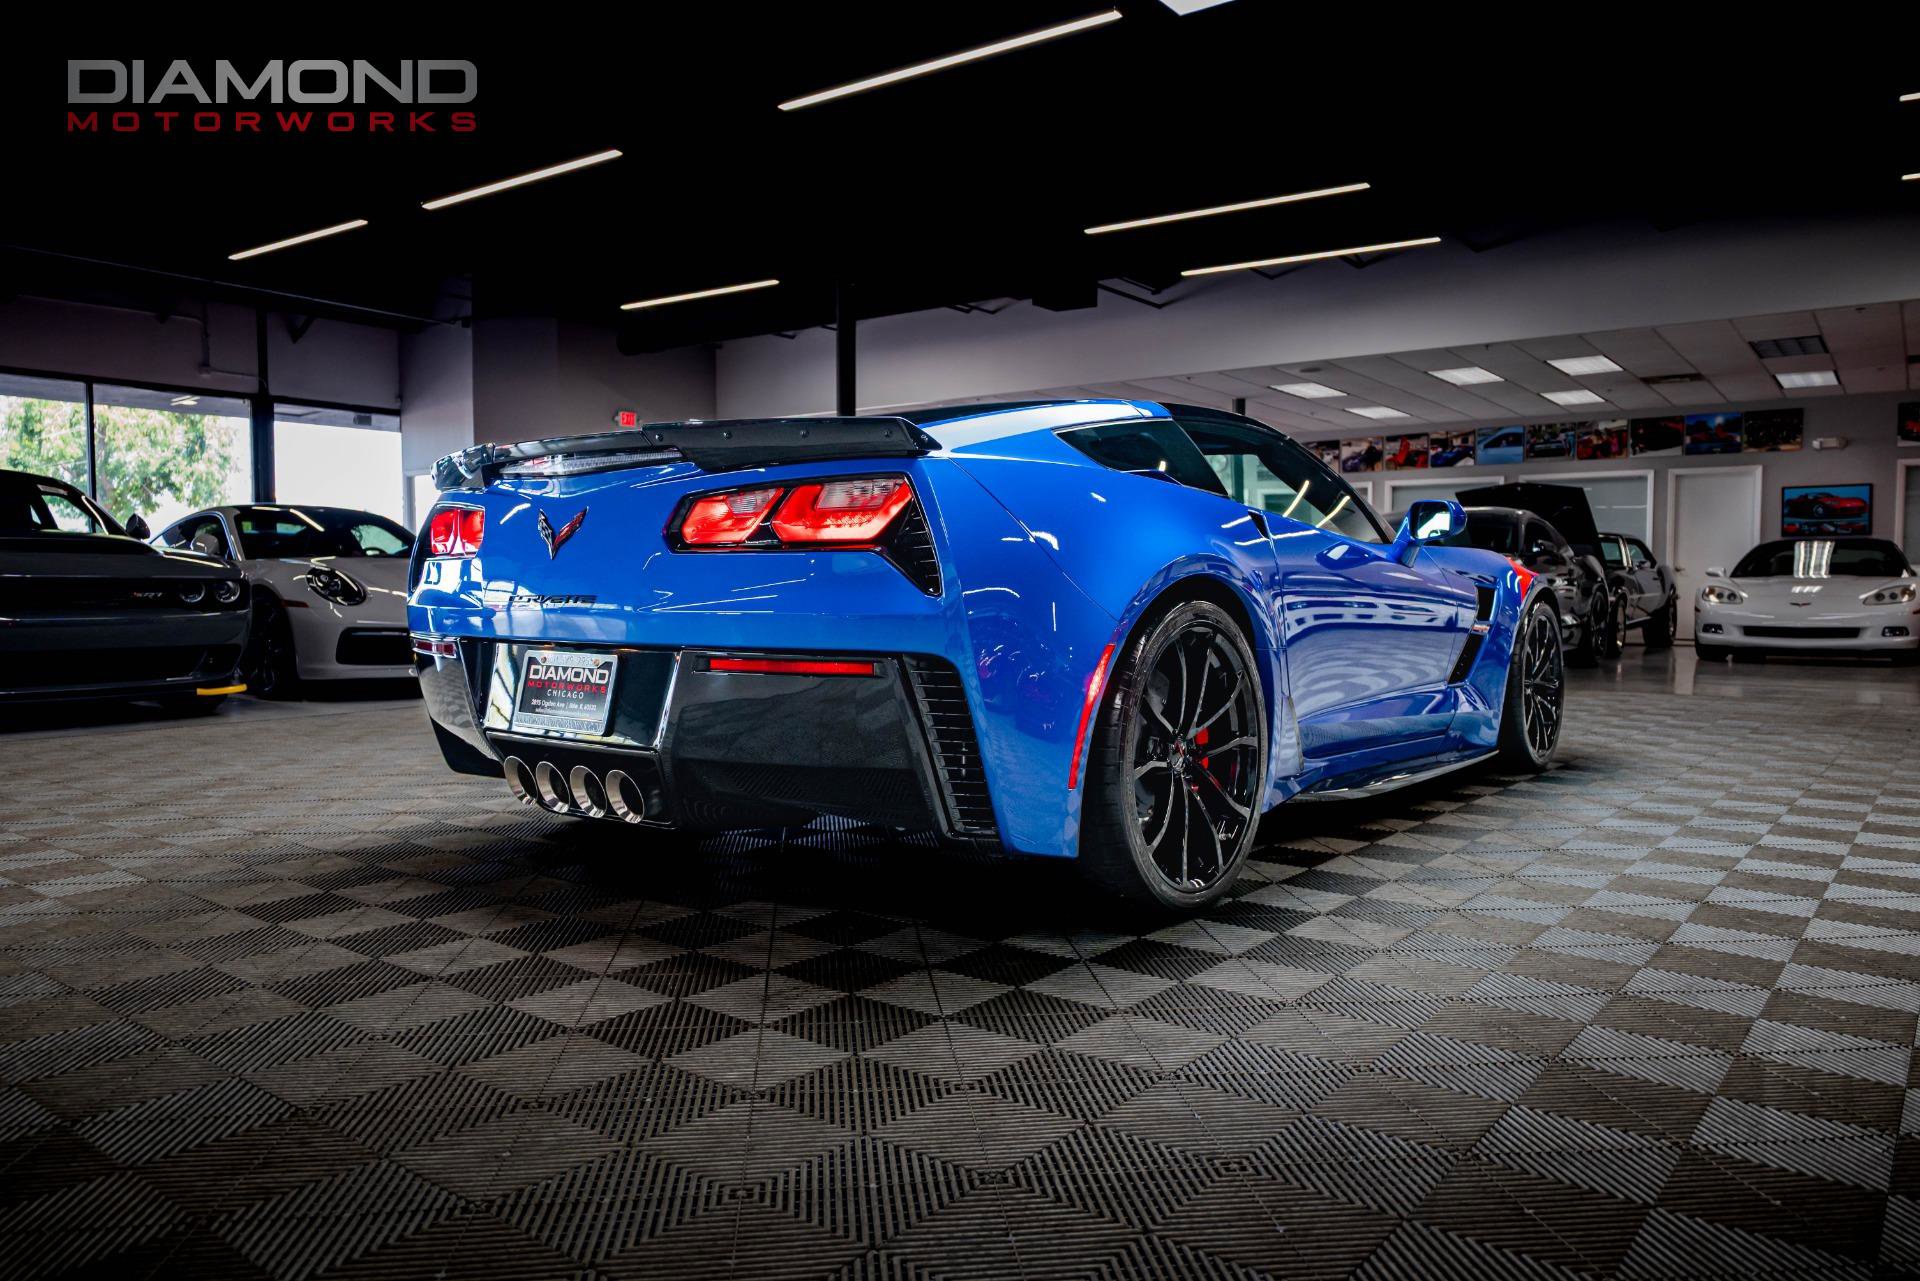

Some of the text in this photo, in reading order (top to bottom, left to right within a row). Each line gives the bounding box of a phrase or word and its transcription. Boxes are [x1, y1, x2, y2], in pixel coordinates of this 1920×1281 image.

[529, 664, 609, 684] DIAMOND
[527, 680, 608, 695] MOTORWORKS
[547, 689, 585, 700] CHICAGO
